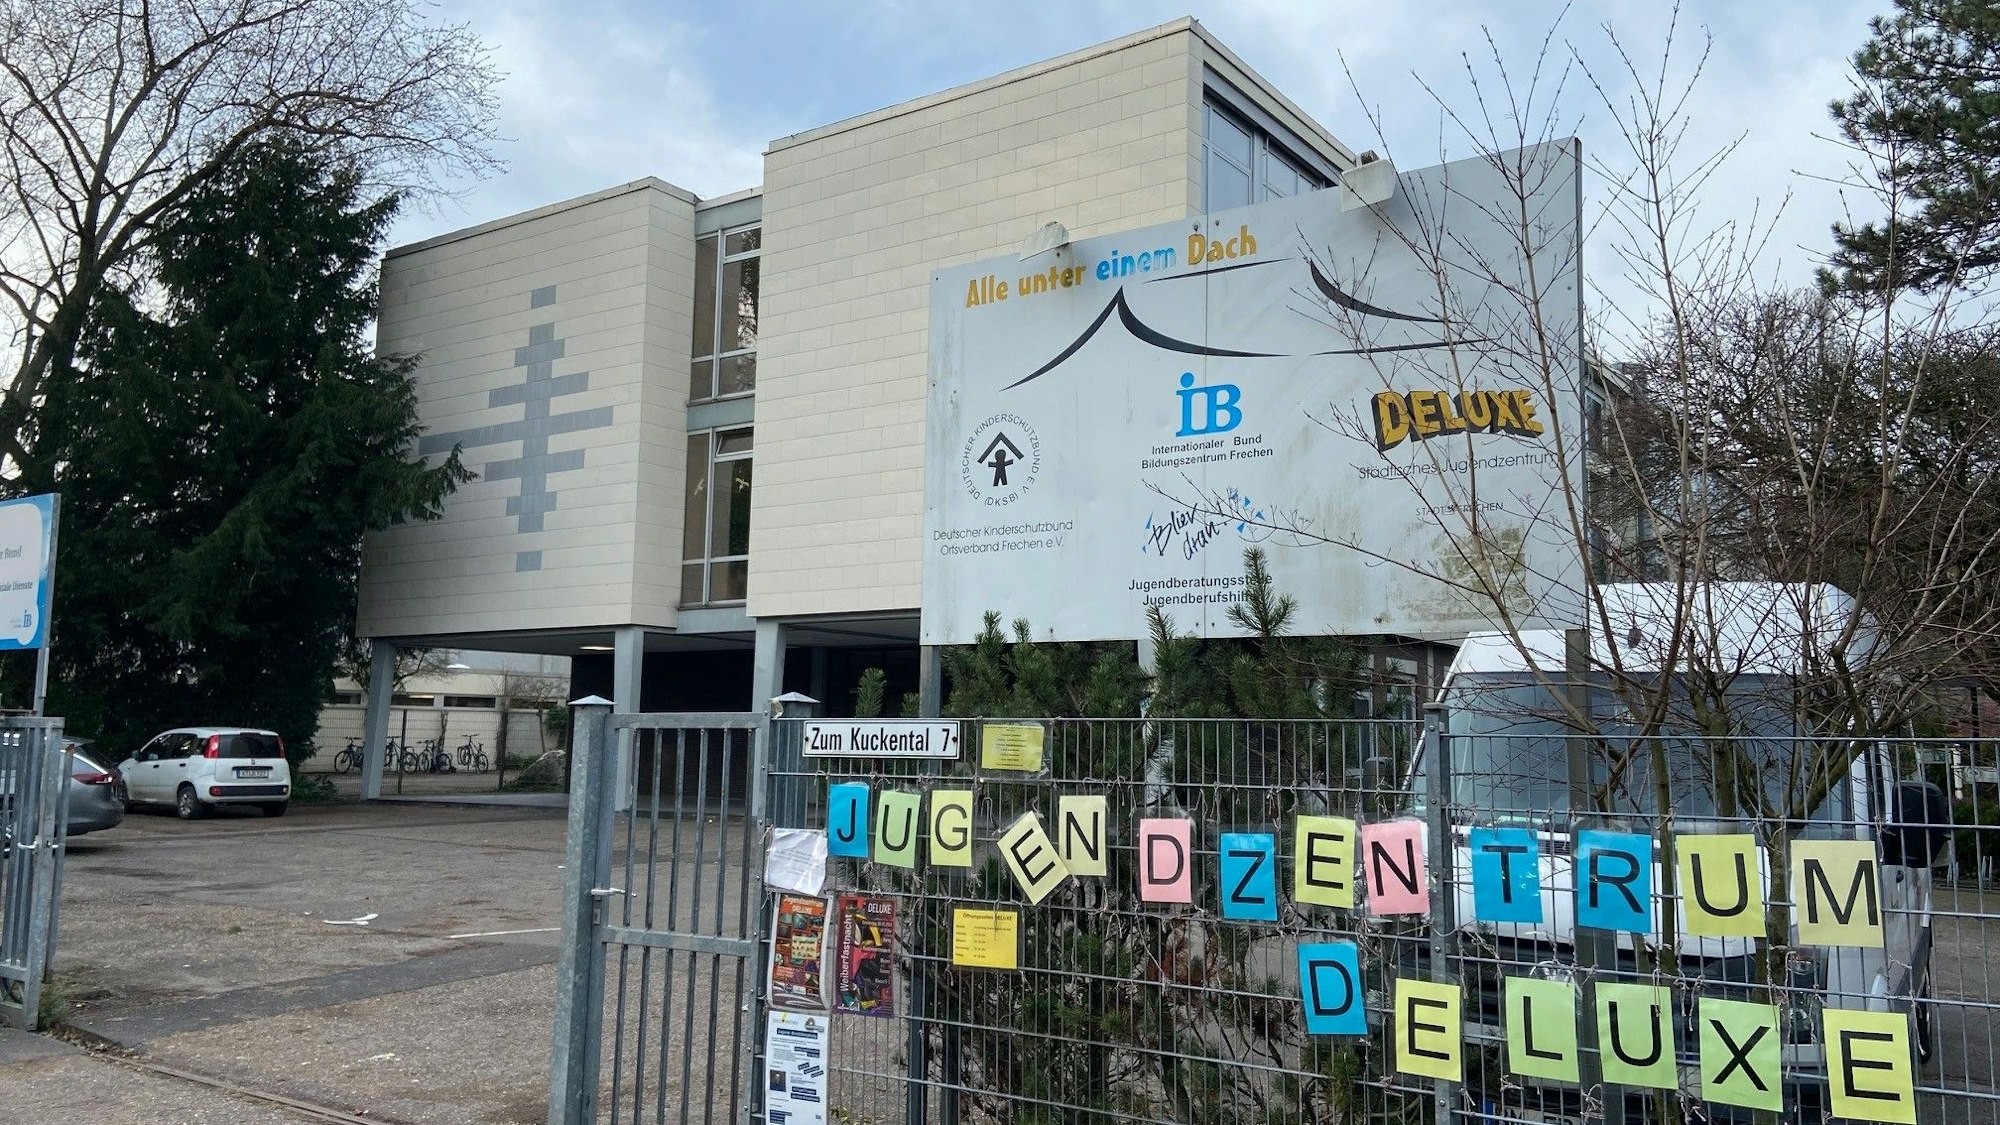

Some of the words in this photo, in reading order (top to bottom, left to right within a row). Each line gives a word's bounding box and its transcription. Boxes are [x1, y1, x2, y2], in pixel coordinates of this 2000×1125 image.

[965, 276, 1008, 308] Alle
[1018, 265, 1087, 297] unter
[1095, 246, 1178, 281] einem
[1187, 225, 1257, 266] Dach
[1371, 390, 1545, 452] DELUXE
[1152, 438, 1225, 455] Internationaler
[1233, 434, 1262, 446] Bund
[1141, 452, 1227, 469] Bildungszentrum
[1229, 447, 1273, 461] Frechen
[933, 527, 982, 541] Deutscher
[984, 519, 1073, 536] Kinderschutzbund
[940, 541, 999, 556] Ortsverband
[1002, 537, 1043, 551] Frechen
[1128, 574, 1273, 592] Jugendberatungsste
[1143, 591, 1250, 608] Jugendberufshil
[811, 727, 842, 751] Zum
[850, 727, 930, 752] Kuckental
[942, 728, 951, 752] 7
[867, 903, 892, 915] DELUXE
[840, 914, 853, 992] Weiberfastnacht
[1308, 959, 1902, 1101] DELUXE
